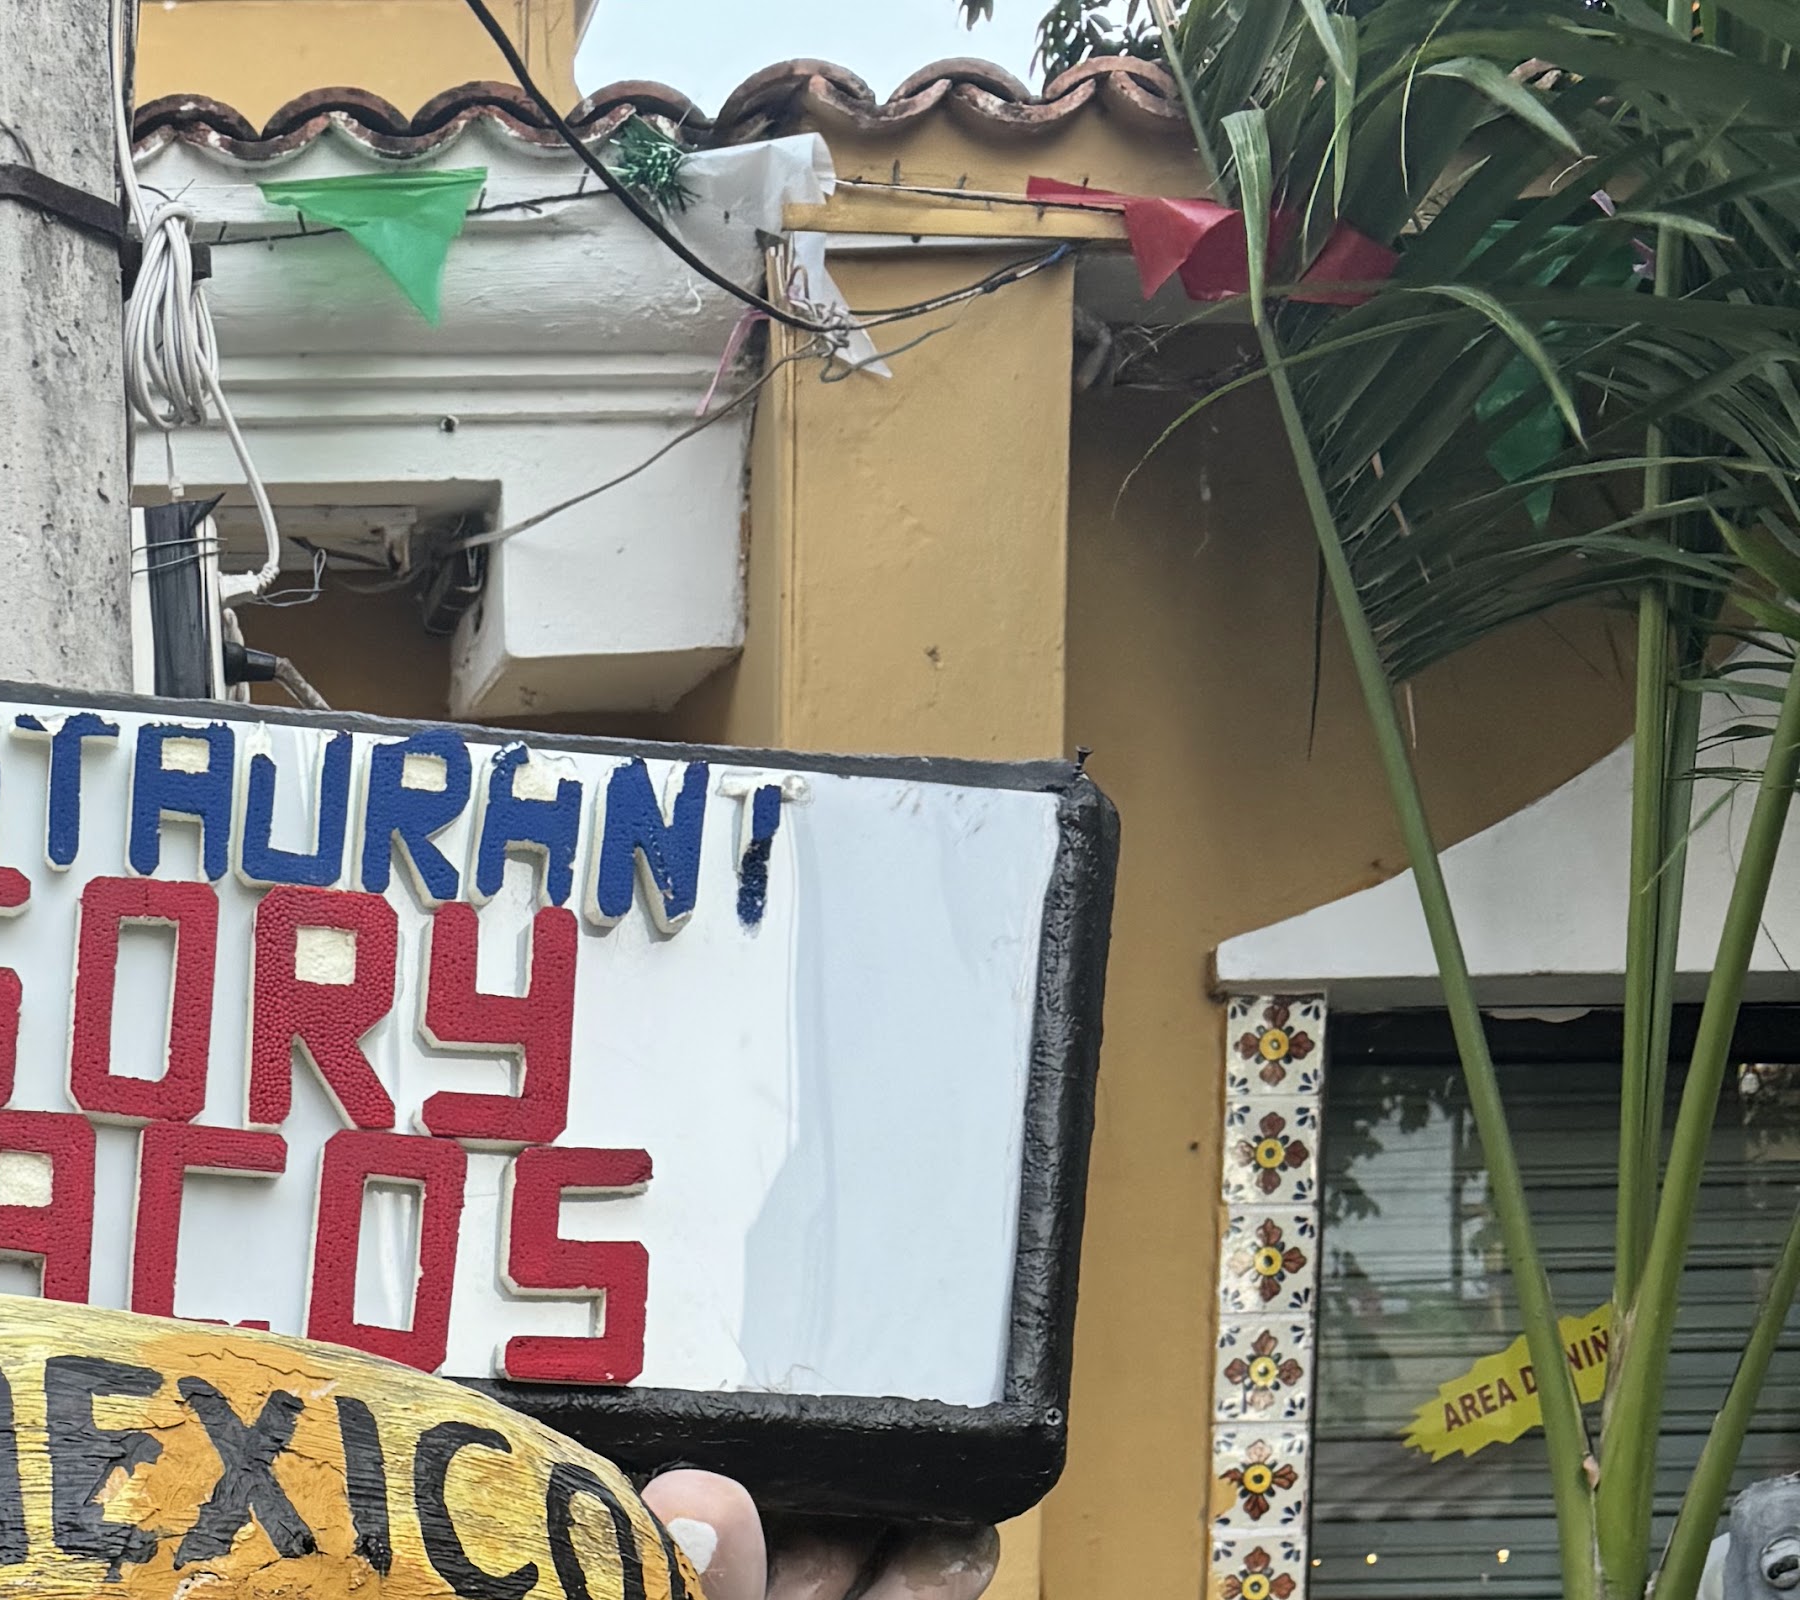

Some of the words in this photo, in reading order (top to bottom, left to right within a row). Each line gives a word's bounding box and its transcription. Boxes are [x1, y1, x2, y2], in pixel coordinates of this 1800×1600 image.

[1442, 1376, 1518, 1433] AREA
[1519, 1365, 1538, 1395] D
[1566, 1324, 1610, 1371] NIÑ
